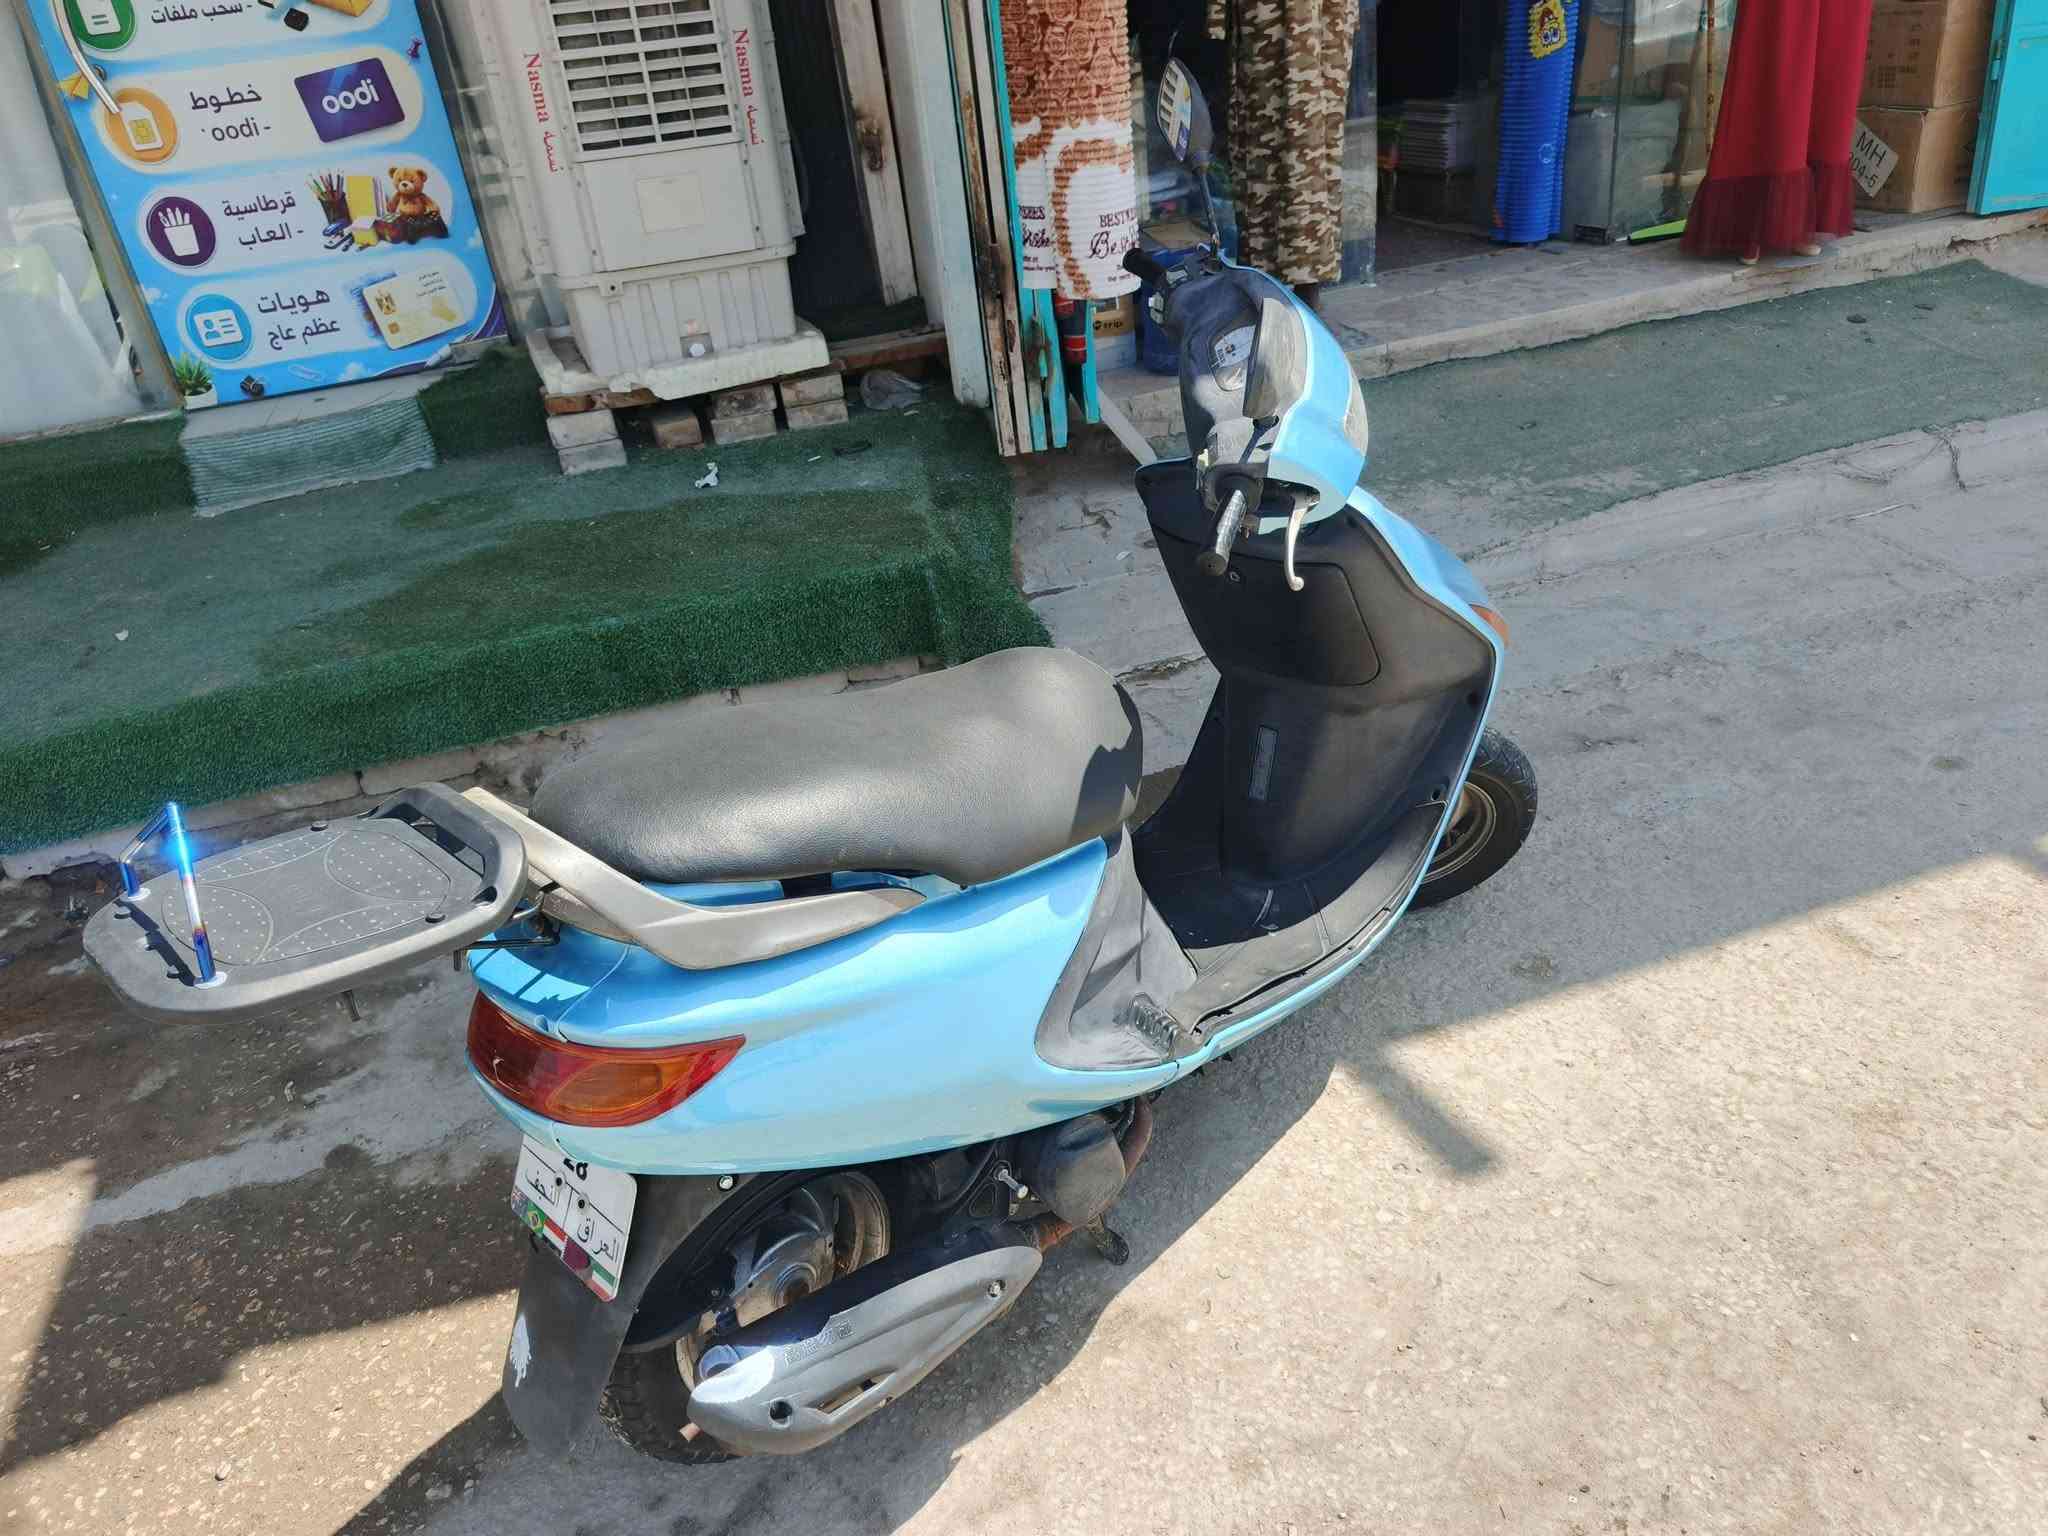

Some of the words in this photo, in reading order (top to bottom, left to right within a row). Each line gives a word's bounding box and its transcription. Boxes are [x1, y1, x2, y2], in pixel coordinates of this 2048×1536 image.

[151, 4, 198, 23] ملفات
[201, 3, 243, 21] سحب
[732, 29, 754, 97] Nasma
[190, 83, 262, 113] خطوط
[321, 78, 380, 114] oodi
[524, 53, 550, 123] Nasma
[211, 117, 260, 142] oodi
[1855, 131, 1886, 168] MH
[221, 191, 297, 221] قرطاسية
[238, 222, 292, 250] العاب
[257, 289, 331, 314] هويات
[267, 325, 297, 351] عاج
[301, 317, 341, 345] عظم
[525, 1167, 559, 1207] النجف
[577, 1217, 620, 1262] العراق
